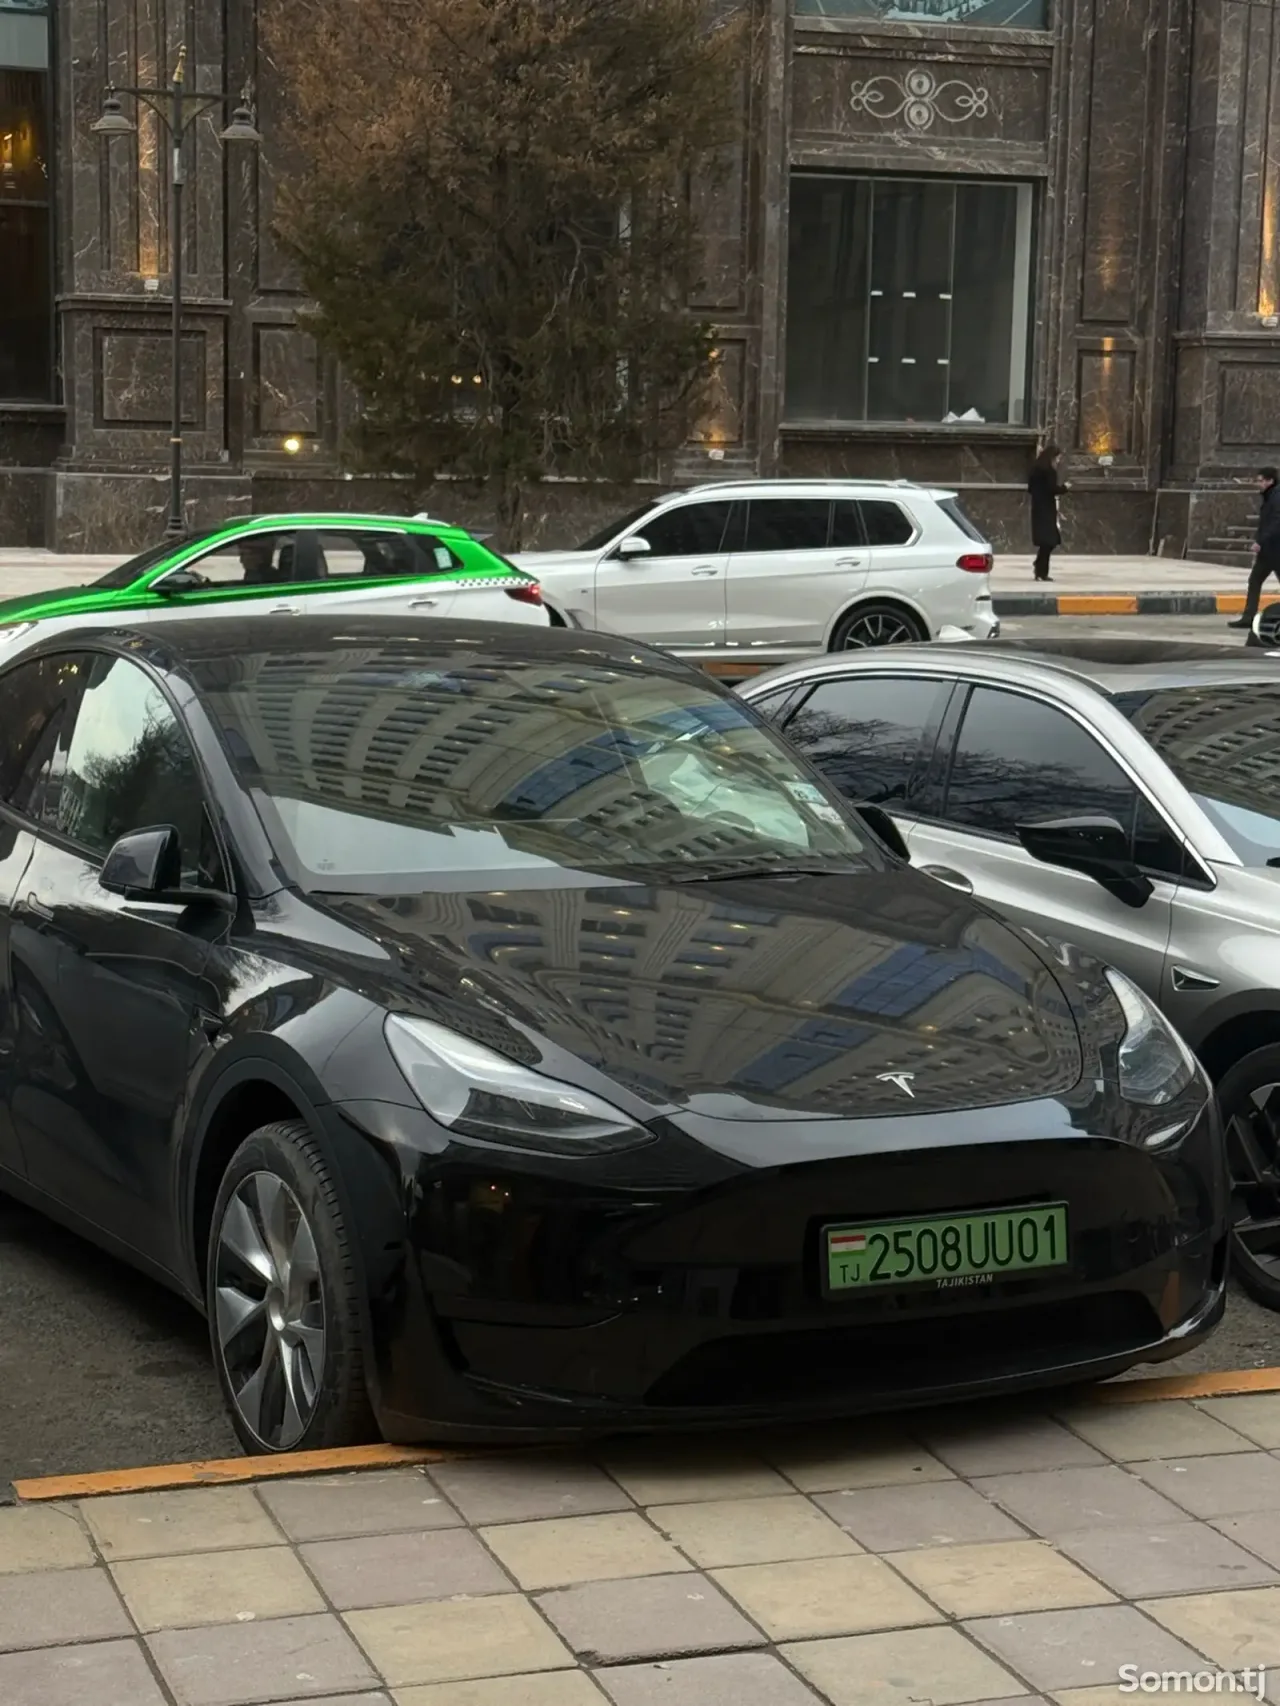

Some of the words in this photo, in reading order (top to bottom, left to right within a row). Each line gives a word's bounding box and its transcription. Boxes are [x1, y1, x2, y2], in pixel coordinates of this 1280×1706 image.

[868, 1214, 1056, 1281] 2508UU01
[839, 1263, 861, 1283] TJ
[936, 1273, 993, 1289] TAJIKISTAN
